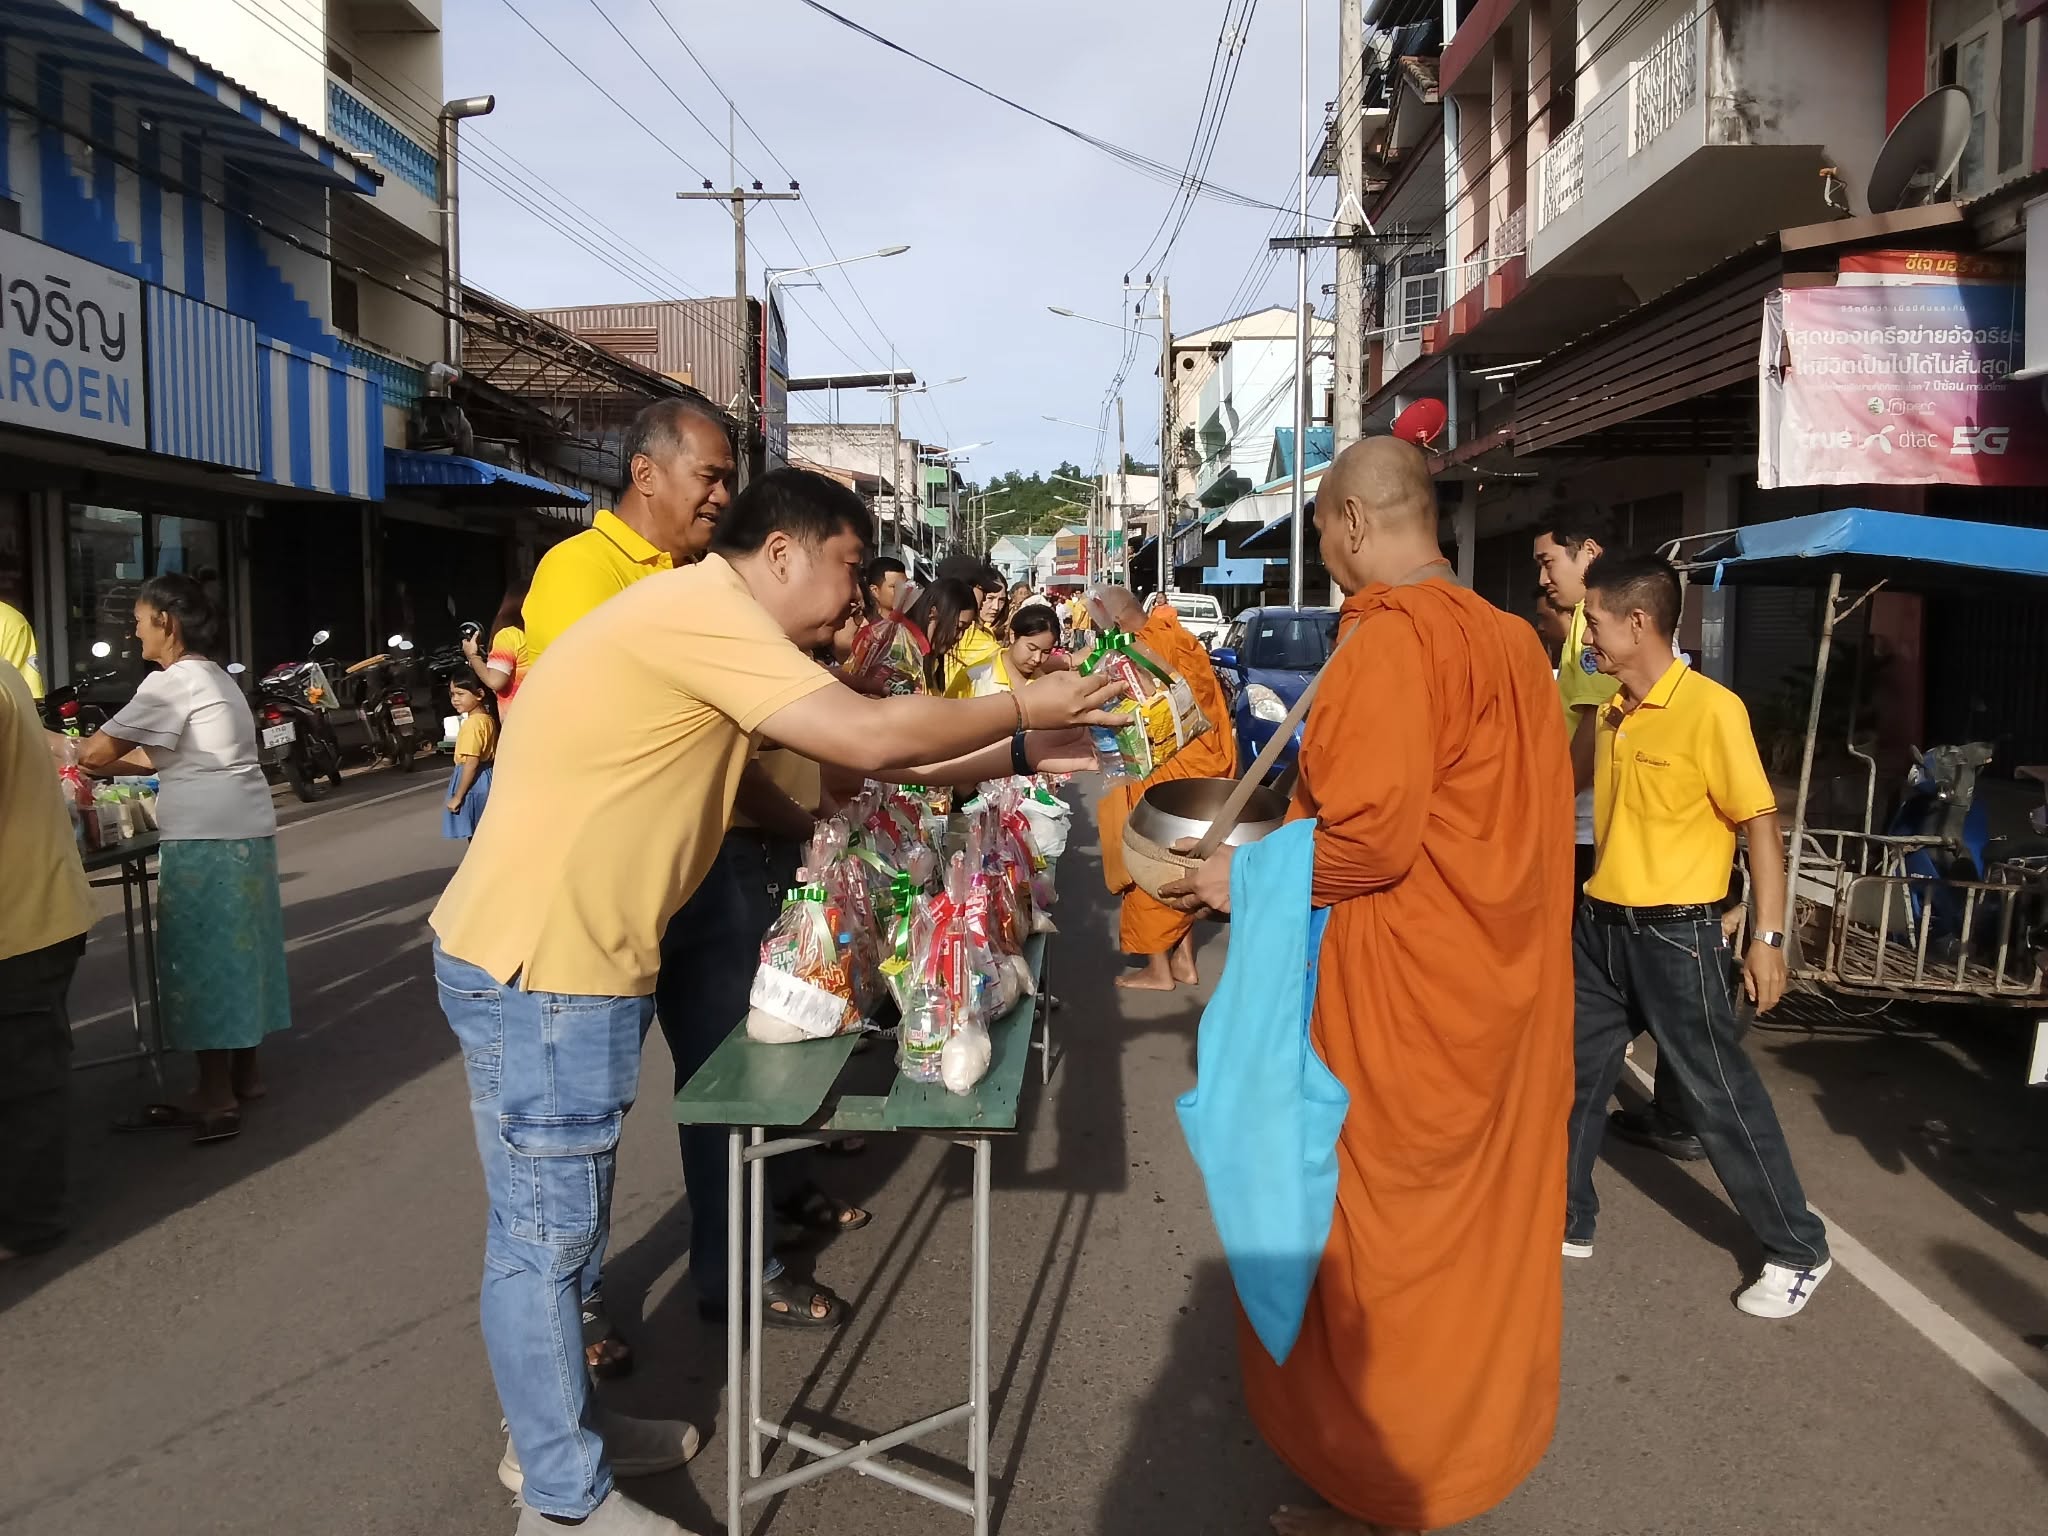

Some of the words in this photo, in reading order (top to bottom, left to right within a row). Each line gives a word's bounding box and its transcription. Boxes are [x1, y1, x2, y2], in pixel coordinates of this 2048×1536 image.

[0, 347, 131, 427] ROEN
[1899, 430, 1938, 448] dtac
[1950, 426, 2010, 455] 5G
